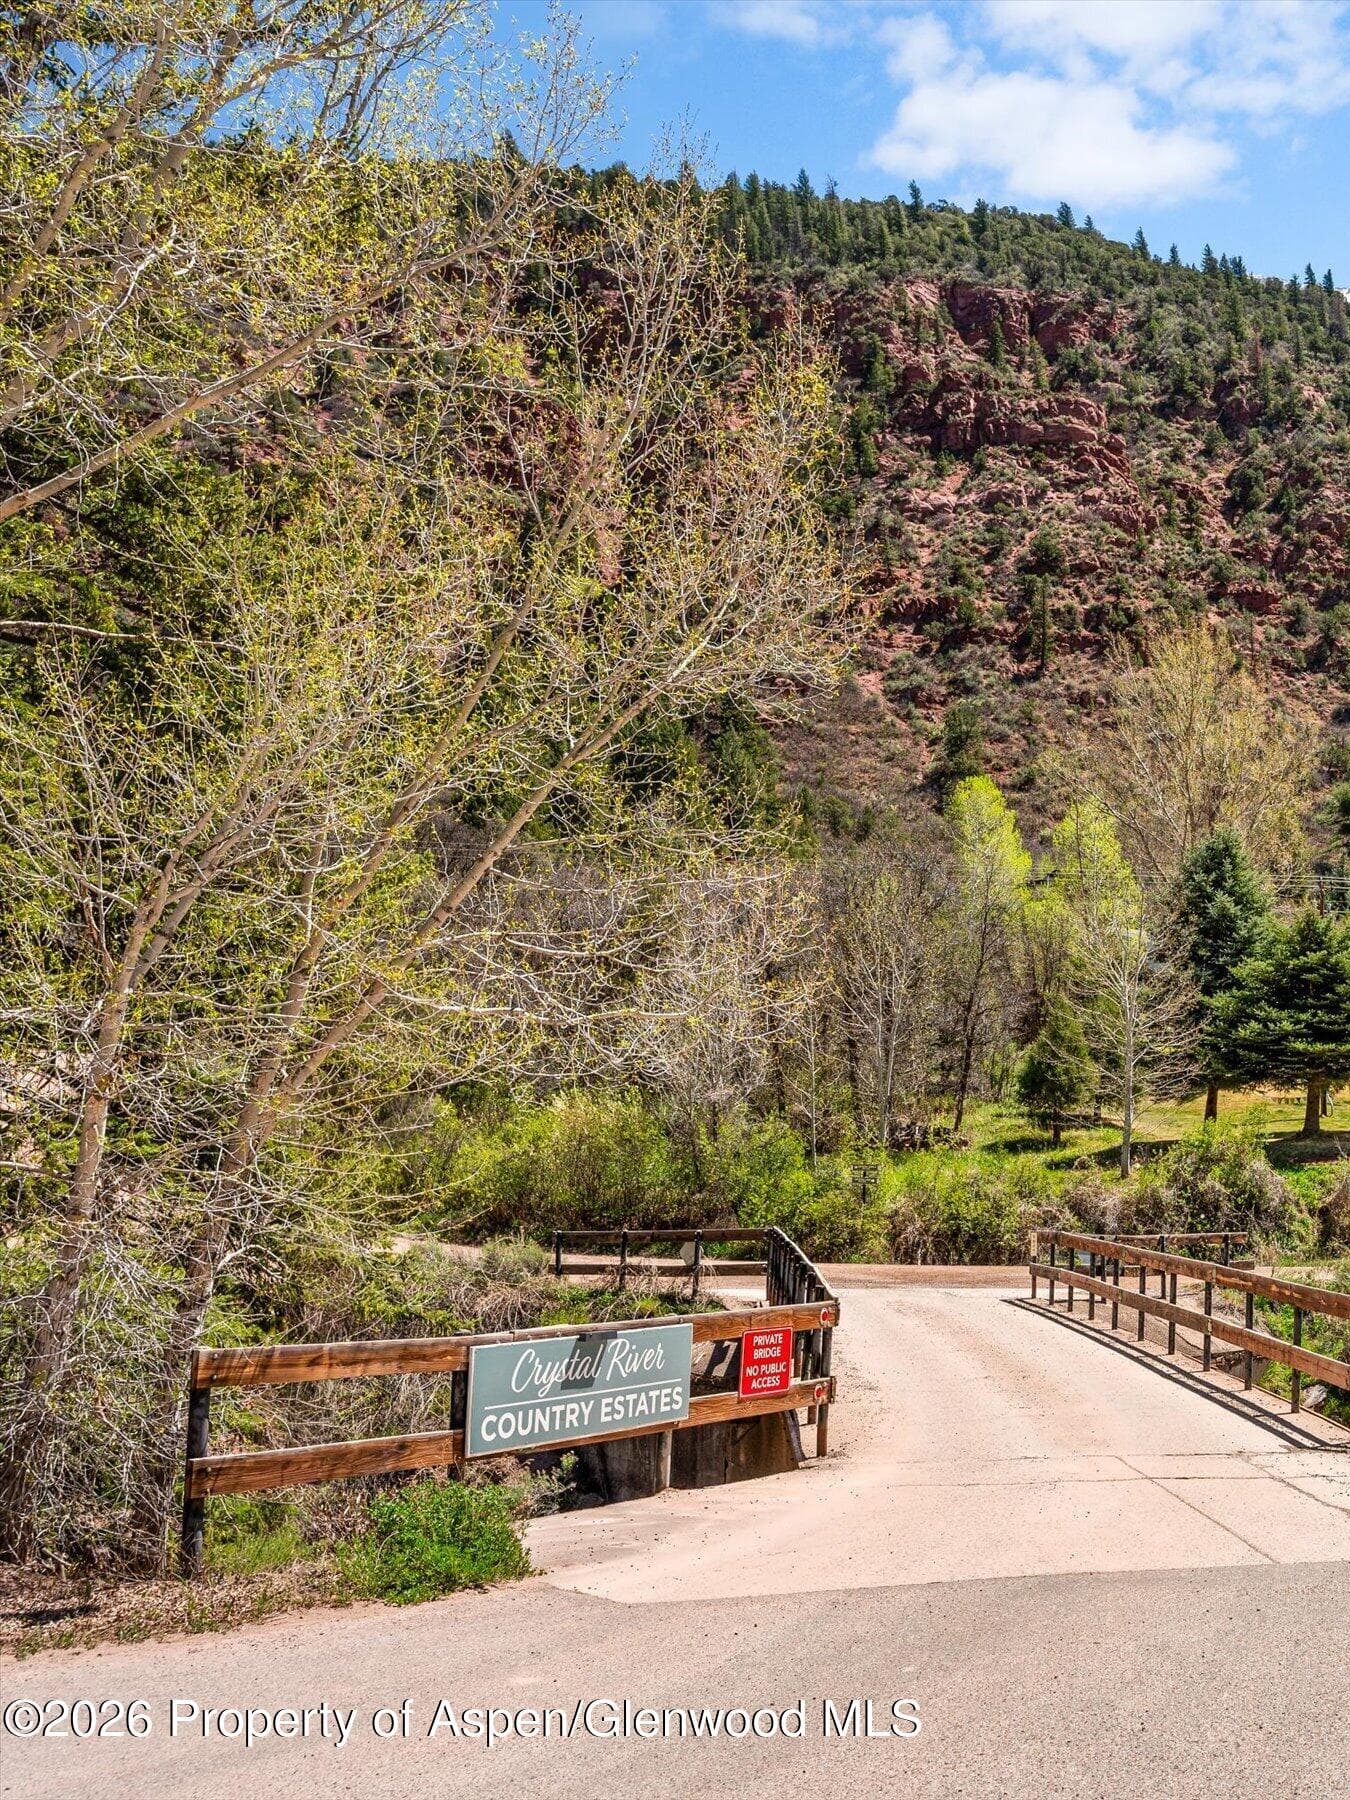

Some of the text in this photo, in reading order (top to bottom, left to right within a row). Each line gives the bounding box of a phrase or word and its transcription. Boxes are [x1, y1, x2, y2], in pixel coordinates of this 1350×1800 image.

[753, 1333, 783, 1346] PRIVATE
[753, 1346, 782, 1359] BRIDGE
[511, 1338, 666, 1396] Crystal River
[746, 1362, 787, 1377] NO PUBLIC
[751, 1375, 780, 1389] ACCESS
[481, 1386, 683, 1442] COUNTRY ESTATES
